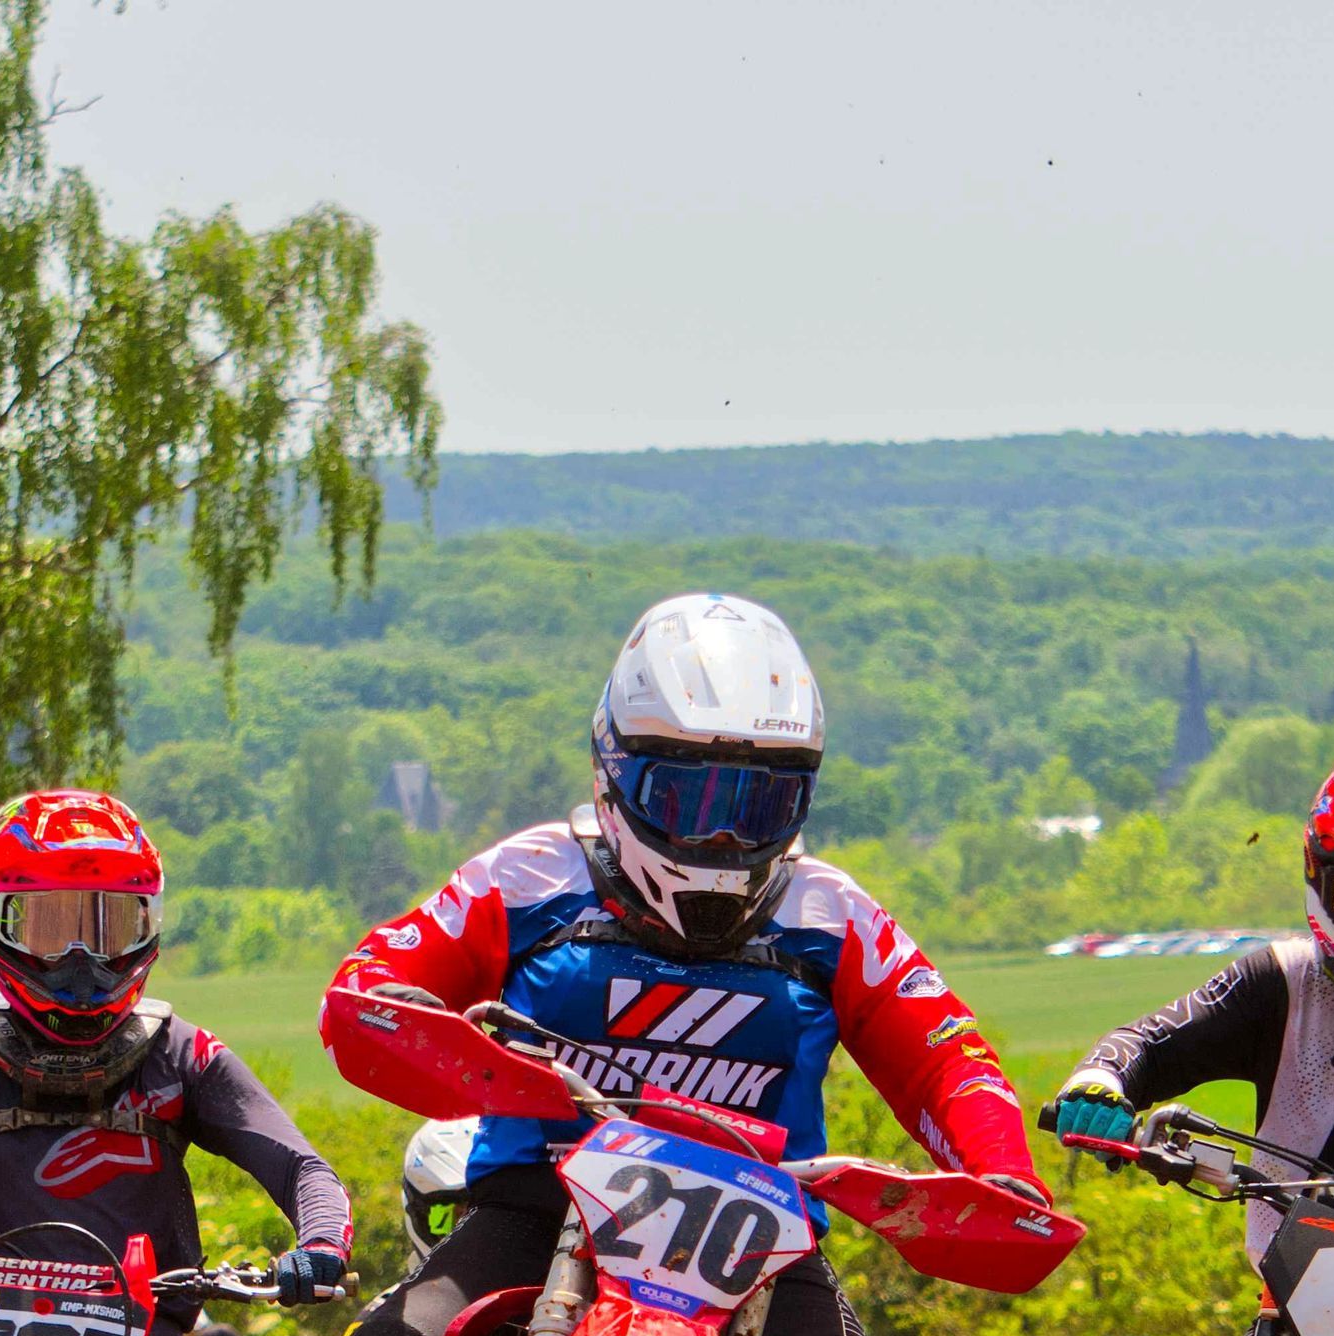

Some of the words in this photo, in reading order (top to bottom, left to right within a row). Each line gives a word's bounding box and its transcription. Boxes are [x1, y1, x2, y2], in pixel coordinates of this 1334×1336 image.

[753, 718, 808, 734] LEATT
[1068, 1083, 1124, 1102] FOX
[736, 1171, 791, 1205] SCHOPPE
[589, 1164, 780, 1296] 210
